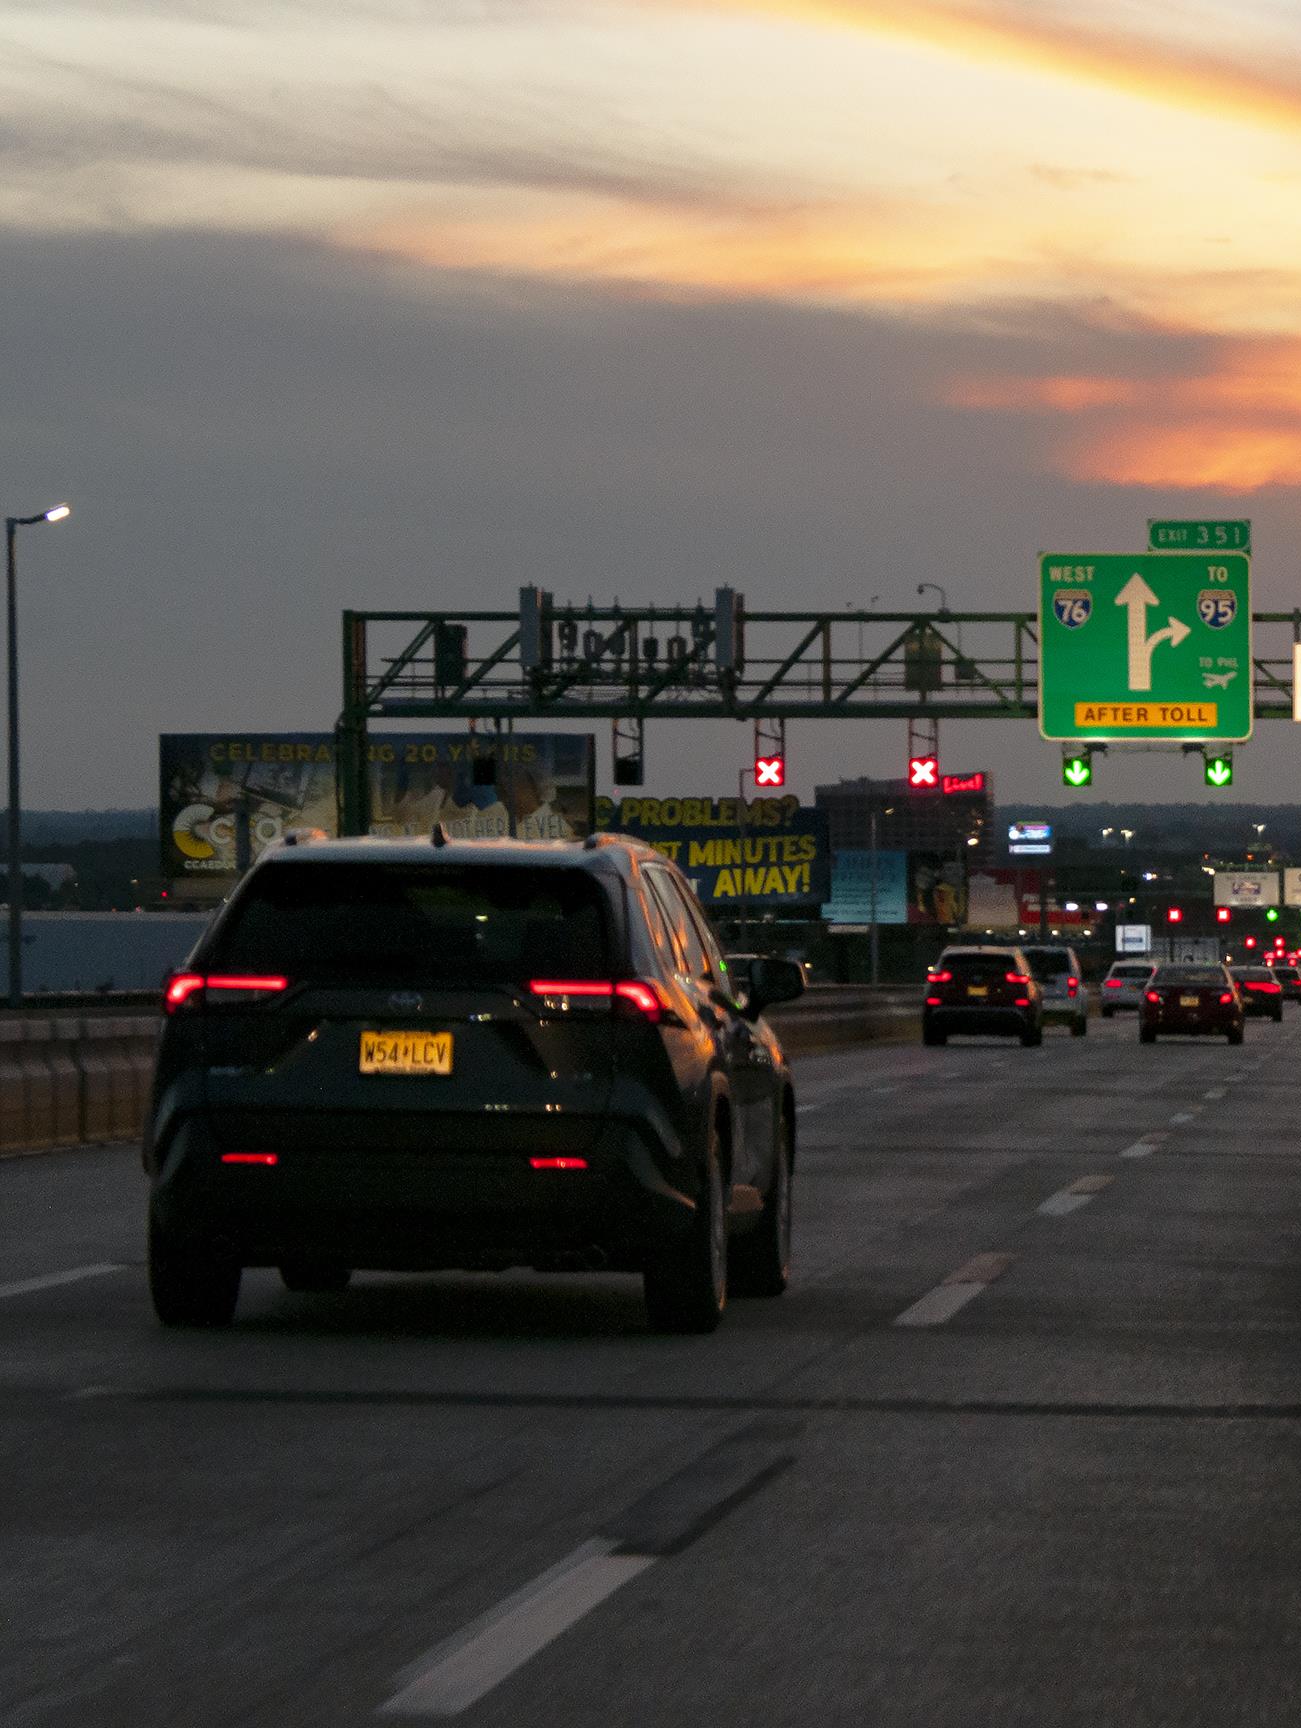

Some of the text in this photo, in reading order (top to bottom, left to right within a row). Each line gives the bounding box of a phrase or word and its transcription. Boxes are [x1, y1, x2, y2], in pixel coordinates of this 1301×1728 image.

[1158, 526, 1240, 544] EXIT 351
[1050, 566, 1095, 582] WEST
[1207, 566, 1228, 582] TO
[1059, 600, 1088, 623] 76
[1201, 601, 1233, 623] 95
[1084, 707, 1208, 722] AFTER TOLL
[208, 743, 537, 763] CELEBRANG 20 YRS
[620, 794, 799, 827] PROBLEMS?
[688, 833, 817, 868] MINUTES
[713, 863, 812, 898] AWAY!
